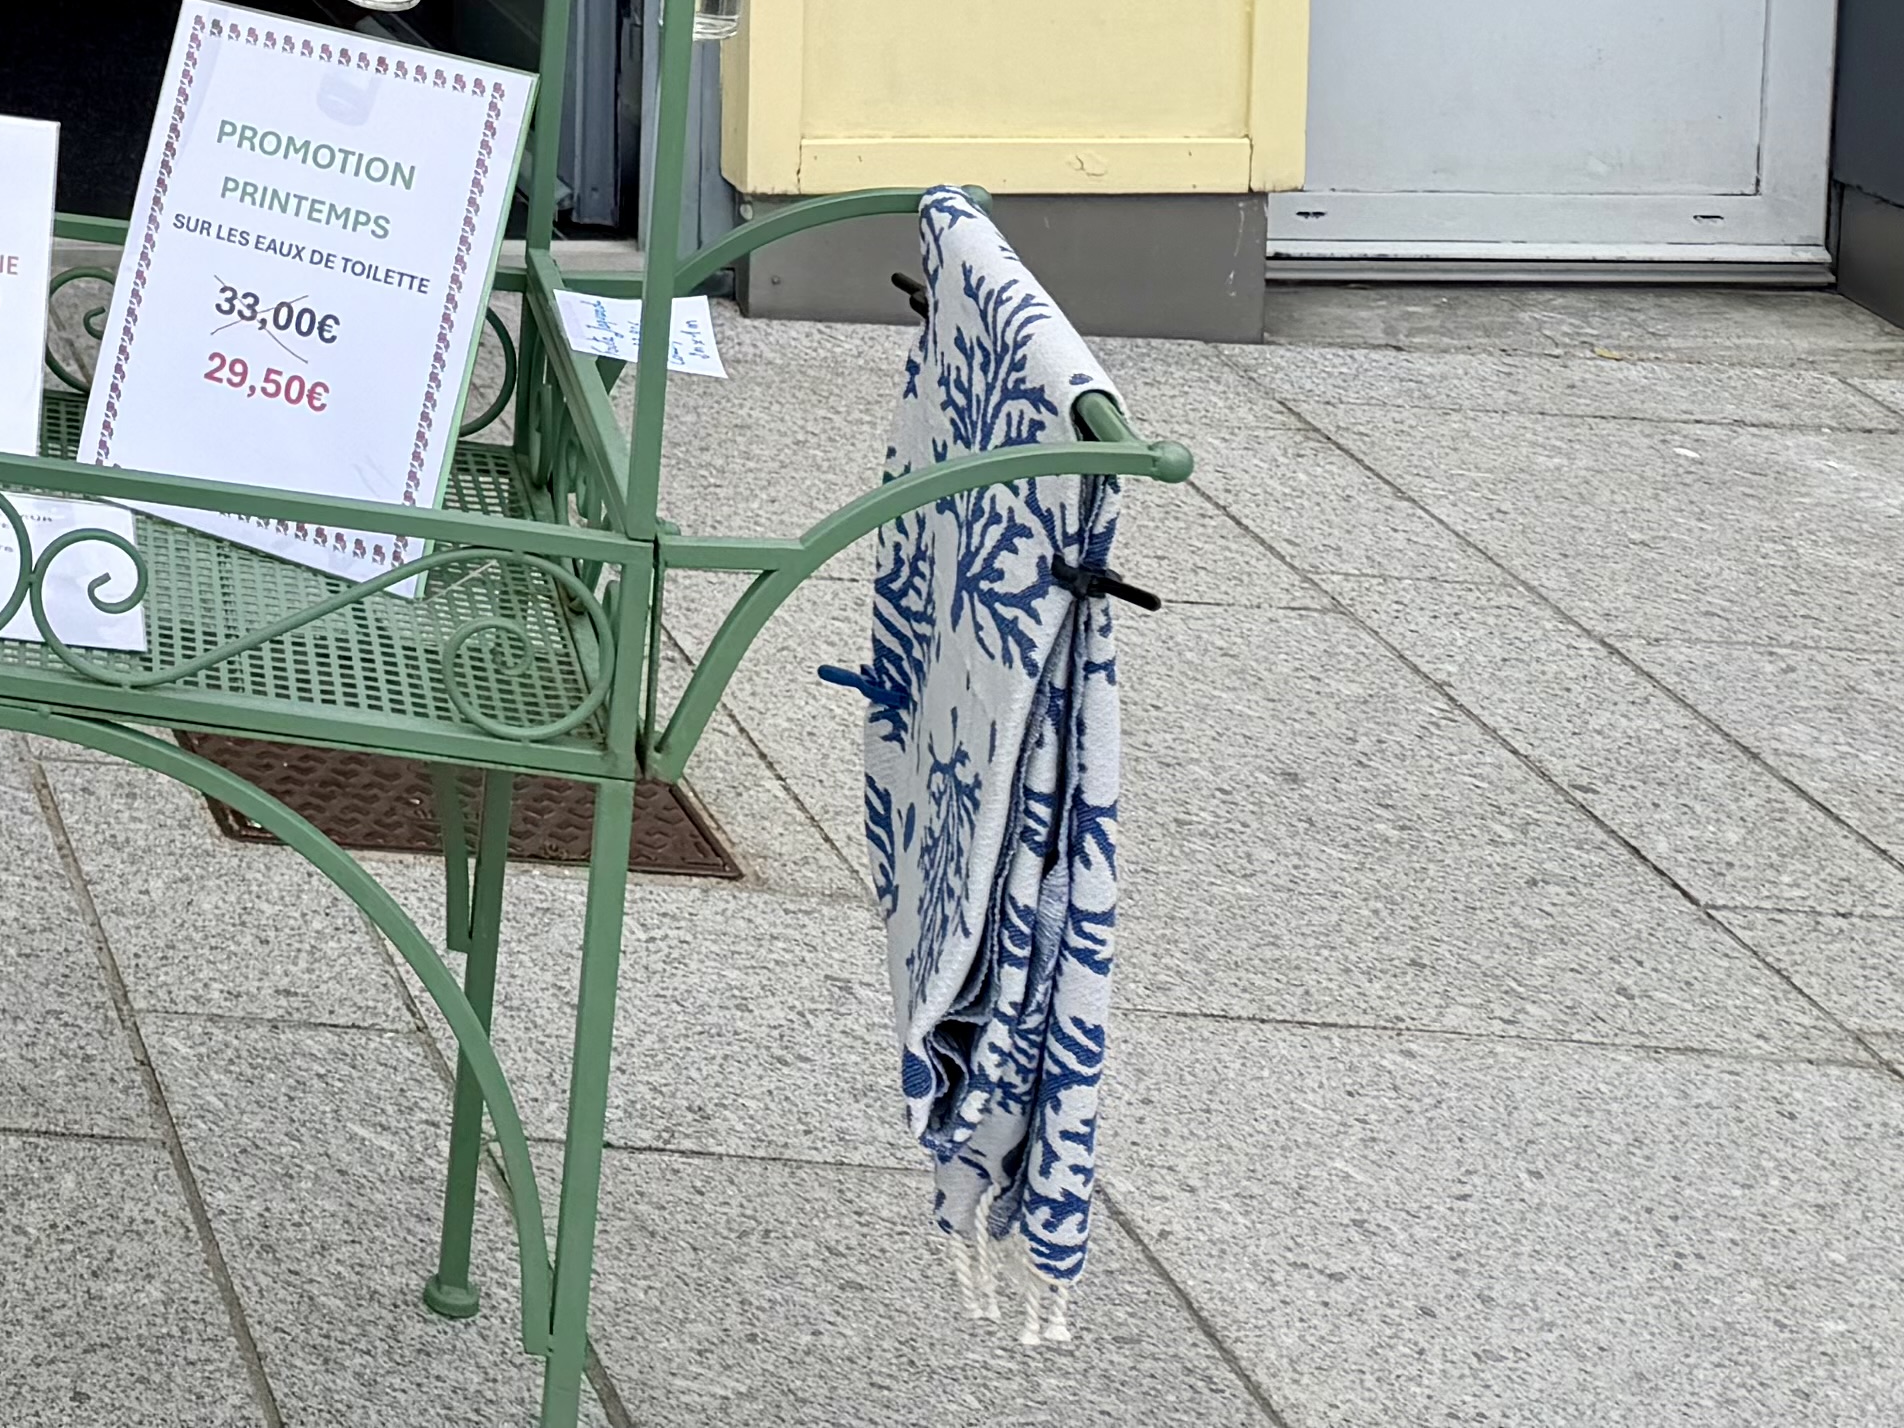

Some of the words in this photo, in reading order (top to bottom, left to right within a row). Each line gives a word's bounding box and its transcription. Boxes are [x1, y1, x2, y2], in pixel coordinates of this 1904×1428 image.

[215, 118, 418, 191] PROMOTION
[220, 175, 392, 240] PRINTEMPS
[172, 213, 212, 237] SUR
[215, 224, 251, 247] LES
[254, 234, 306, 262] EAUX
[309, 249, 338, 270] DE
[341, 256, 431, 294] TOILETTE
[214, 285, 341, 345] 33,00€
[203, 351, 331, 413] 29,50€
